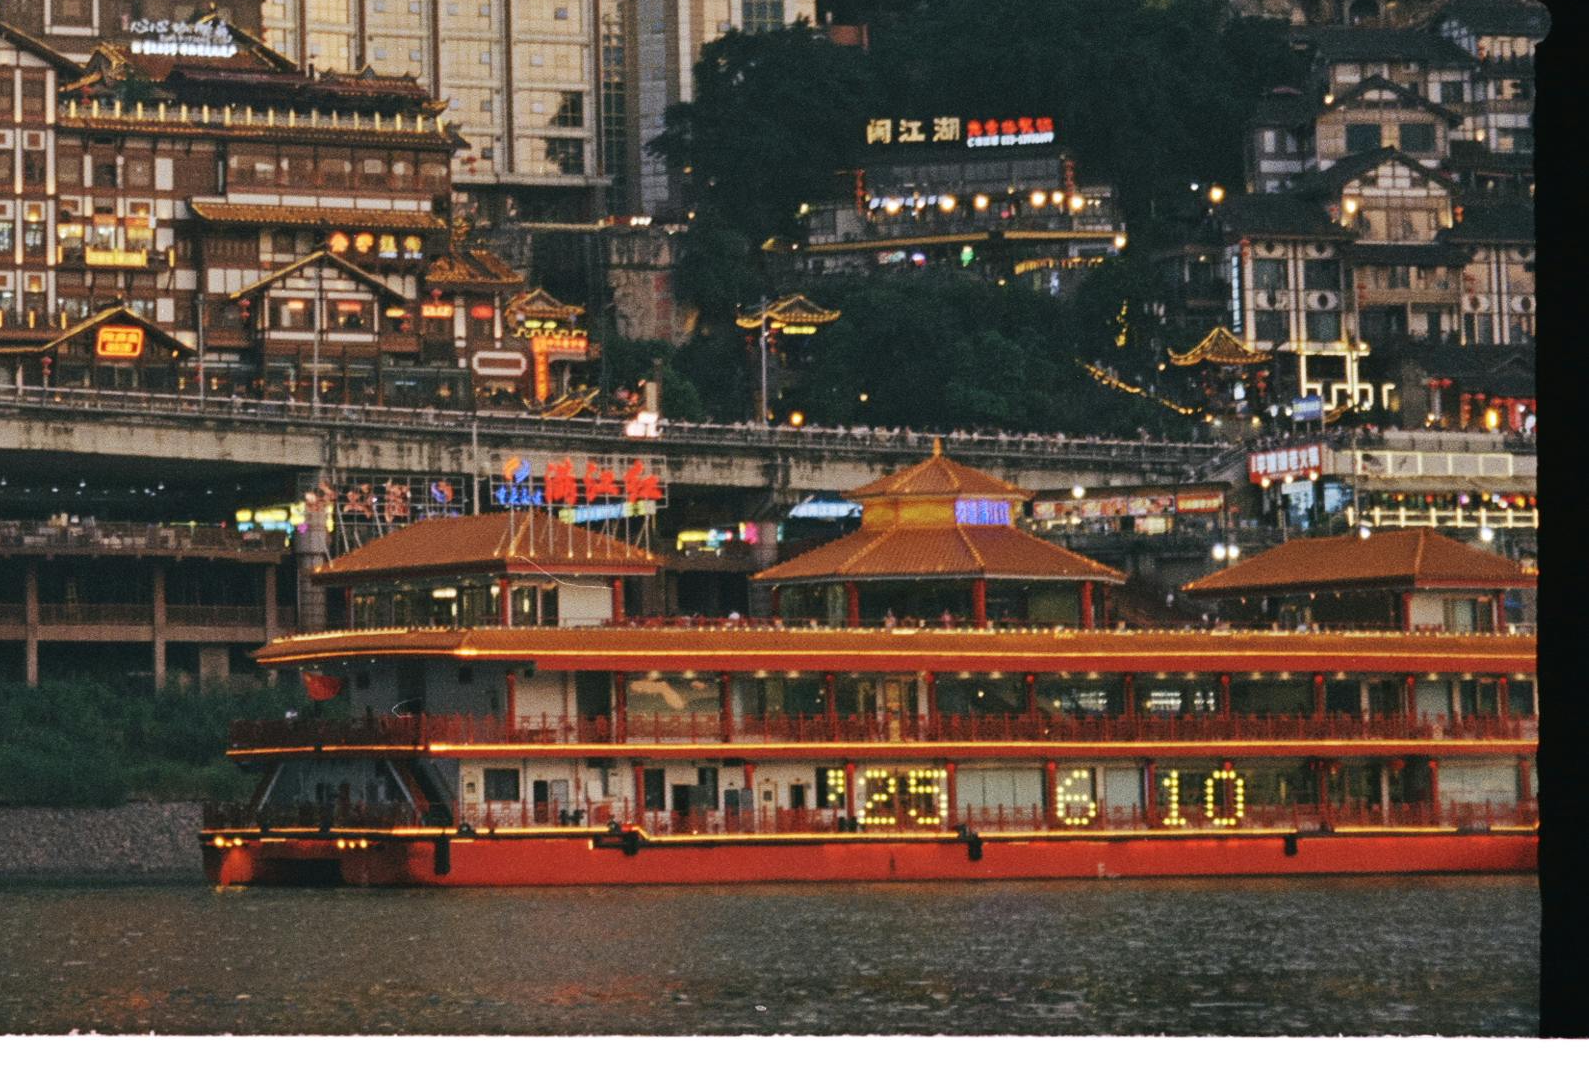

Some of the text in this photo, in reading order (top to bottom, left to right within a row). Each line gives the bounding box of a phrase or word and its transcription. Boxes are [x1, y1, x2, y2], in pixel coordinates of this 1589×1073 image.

[858, 770, 948, 825] 25
[1056, 770, 1097, 825] 6
[1162, 770, 1245, 825] 10
